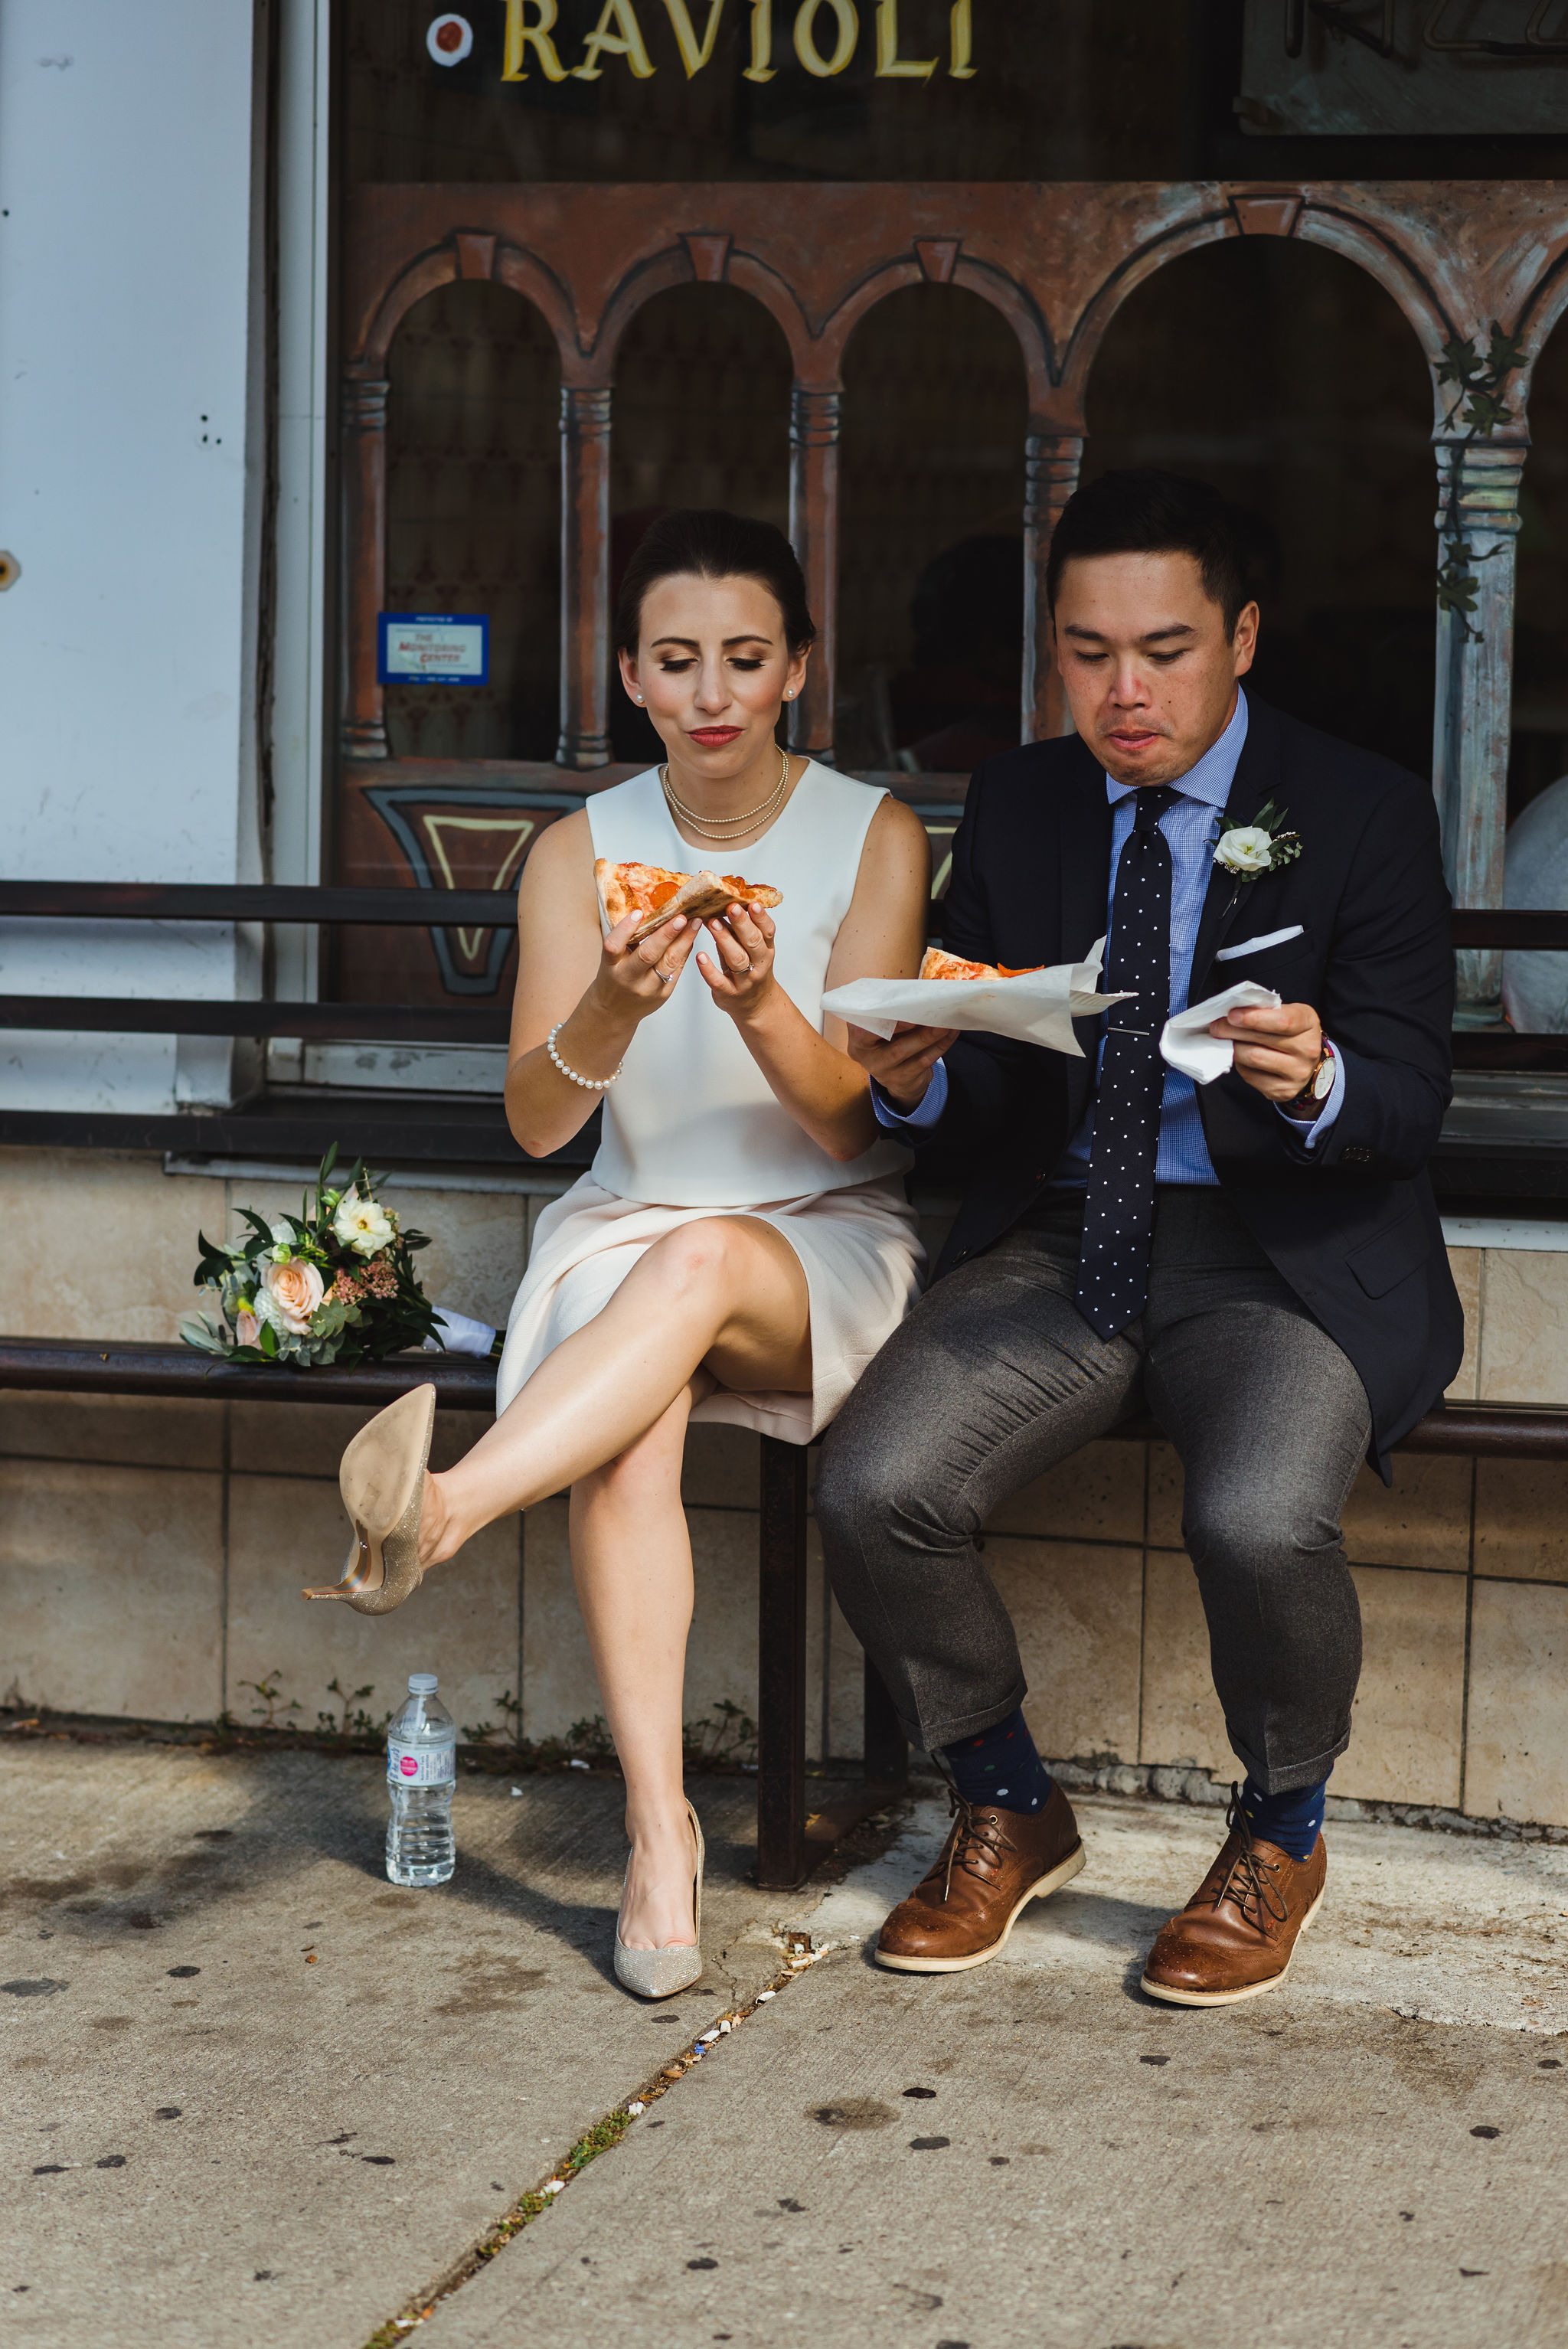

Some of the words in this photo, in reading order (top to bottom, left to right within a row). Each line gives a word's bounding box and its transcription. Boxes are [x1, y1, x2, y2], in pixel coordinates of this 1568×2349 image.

[501, 0, 978, 87] RAVIOLI
[416, 632, 433, 642] THE
[399, 642, 466, 652] MONITORING
[420, 653, 460, 663] CENTER
